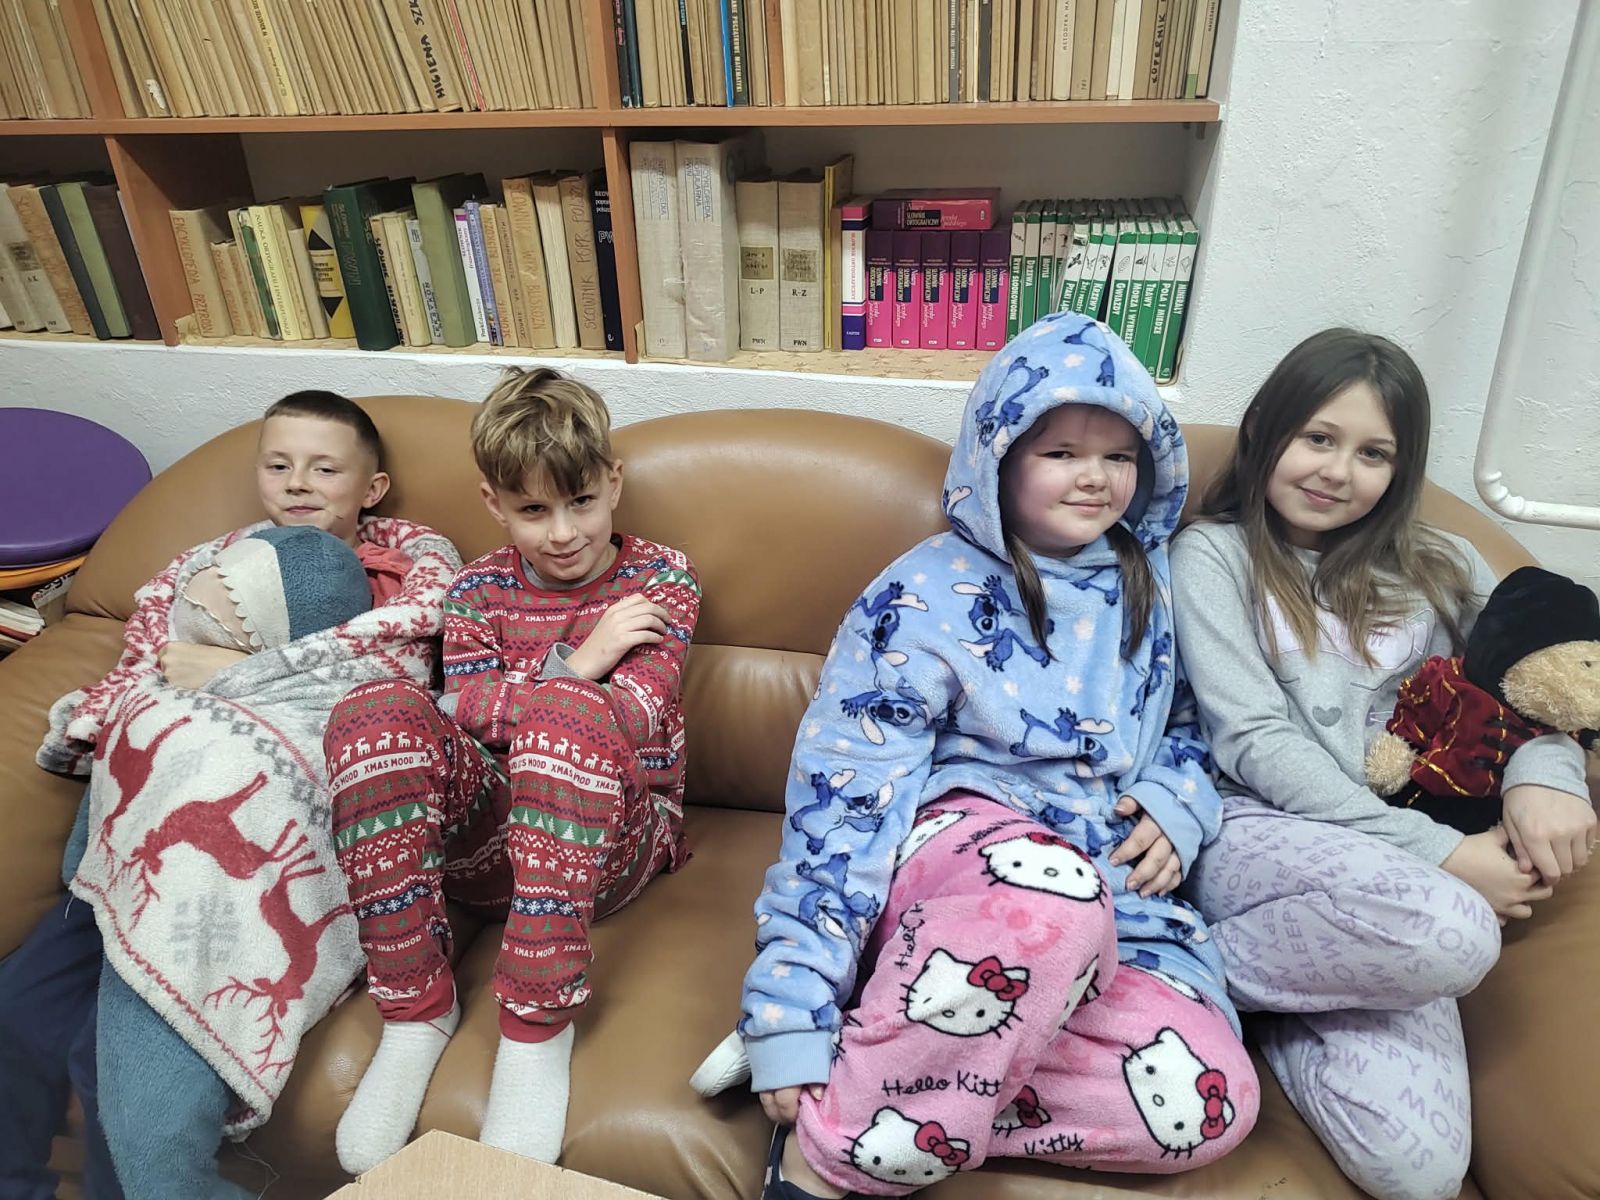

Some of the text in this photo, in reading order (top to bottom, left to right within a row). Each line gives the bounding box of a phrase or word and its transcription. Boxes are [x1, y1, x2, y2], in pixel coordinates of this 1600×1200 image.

[1062, 13, 1070, 50] METODYKA
[1151, 13, 1167, 84] KOPERNIK
[420, 34, 446, 99] HIGIENA
[1025, 259, 1036, 287] DRZEWA
[750, 287, 764, 295] L-P
[792, 289, 808, 297] R-Z
[1009, 274, 1020, 321] SŁODKOWODNE
[1064, 282, 1076, 300] PTAKI
[1088, 282, 1104, 312] KRZEWY
[1112, 282, 1126, 316] GWIAZDY
[1131, 282, 1142, 308] MORZA
[1143, 282, 1156, 308] TRAWY
[1161, 282, 1172, 302] POLA
[1173, 282, 1187, 315] MINERAŁY
[1153, 308, 1164, 335] MIEDZE
[545, 614, 567, 622] MOOD
[364, 683, 395, 695] MOOD
[554, 682, 605, 704] XMAS MOOD
[341, 769, 359, 785] MOOD
[363, 760, 389, 775] XMAS
[390, 756, 414, 767] MOOD
[528, 757, 546, 769] MOOD
[550, 764, 573, 778] XMAS
[595, 781, 615, 790] XMAS
[377, 943, 396, 952] XMAS
[398, 934, 422, 950] MOOD
[514, 943, 586, 959] XMAS MOOD XMAS
[881, 1069, 1005, 1097] Hello Kitt
